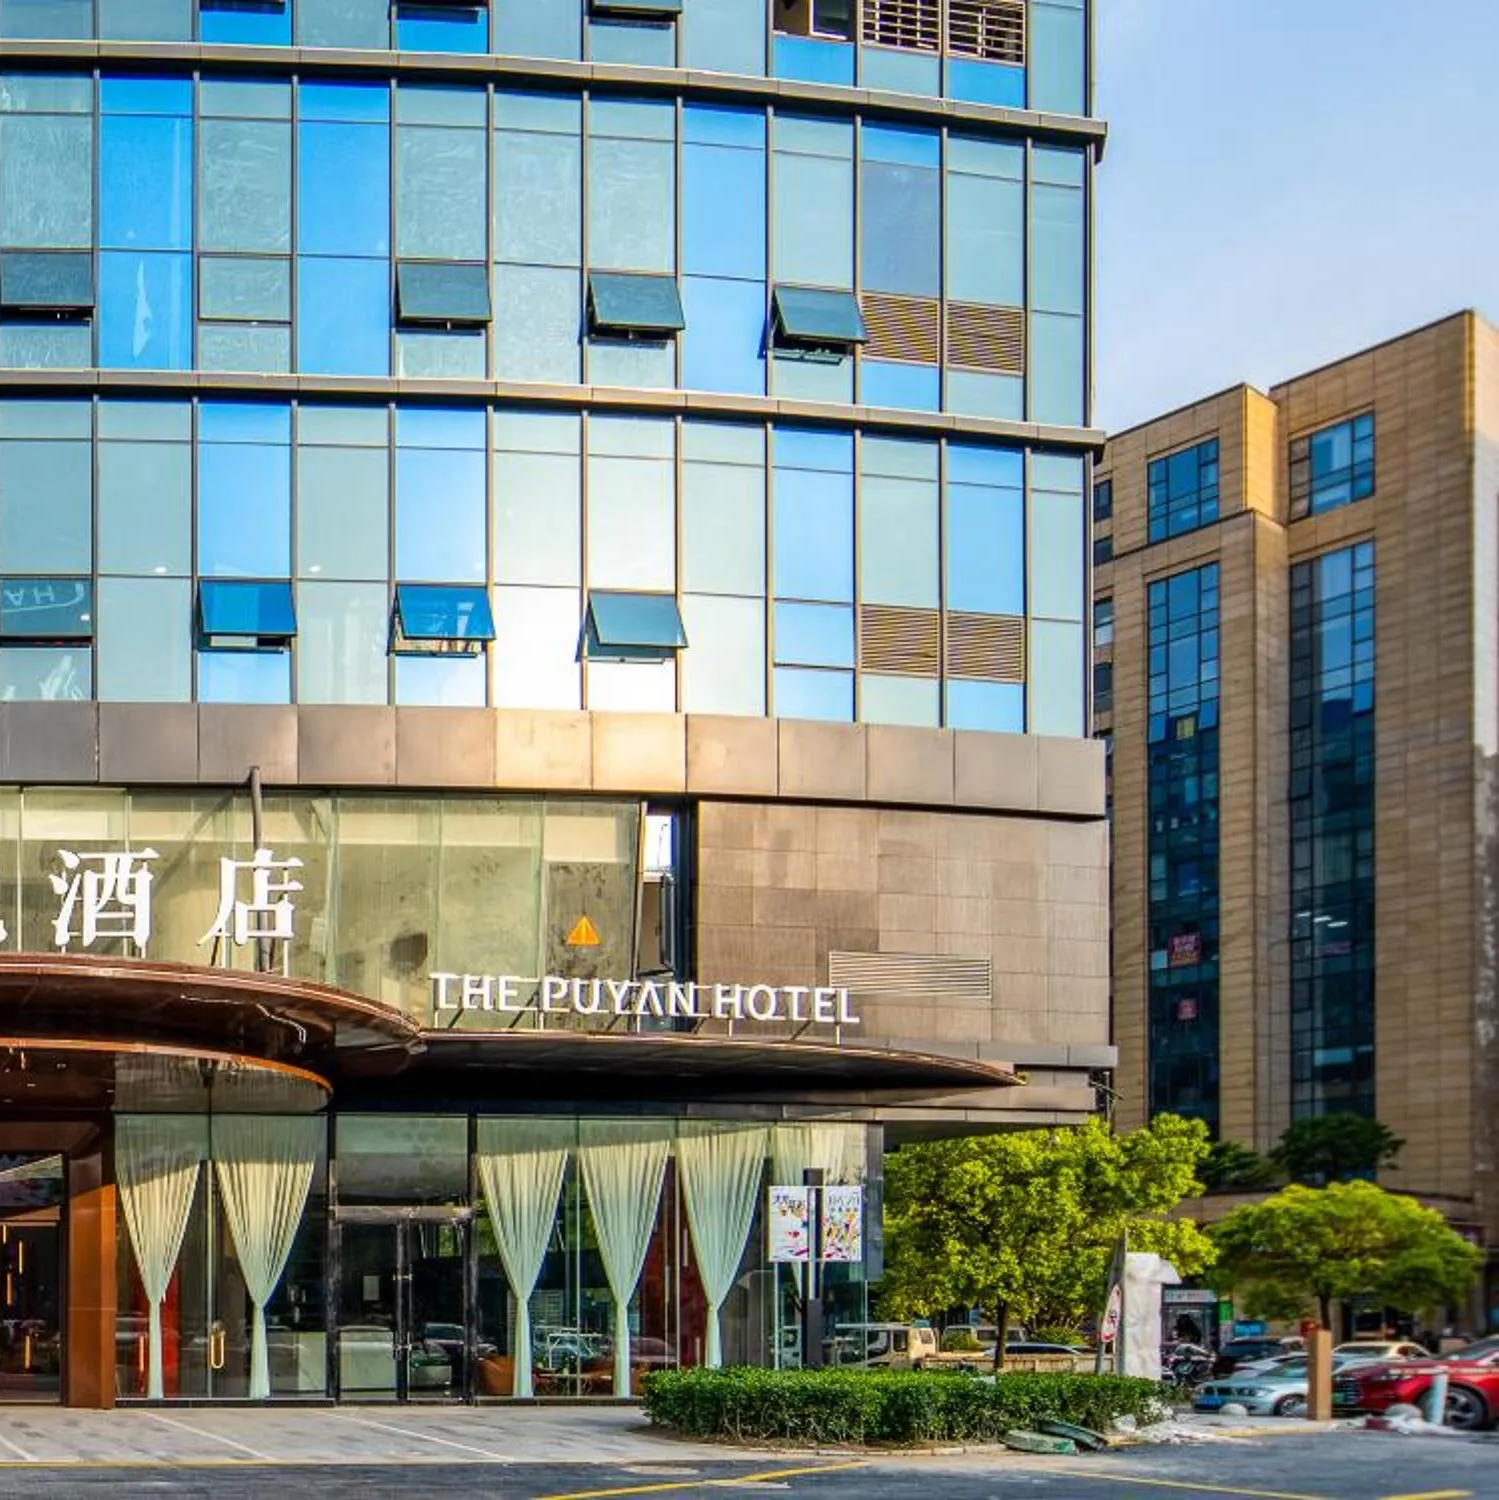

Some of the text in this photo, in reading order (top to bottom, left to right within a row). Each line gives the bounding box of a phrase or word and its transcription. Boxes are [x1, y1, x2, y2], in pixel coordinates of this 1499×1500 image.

[431, 972, 861, 1024] THE PUYAN HOTEL
